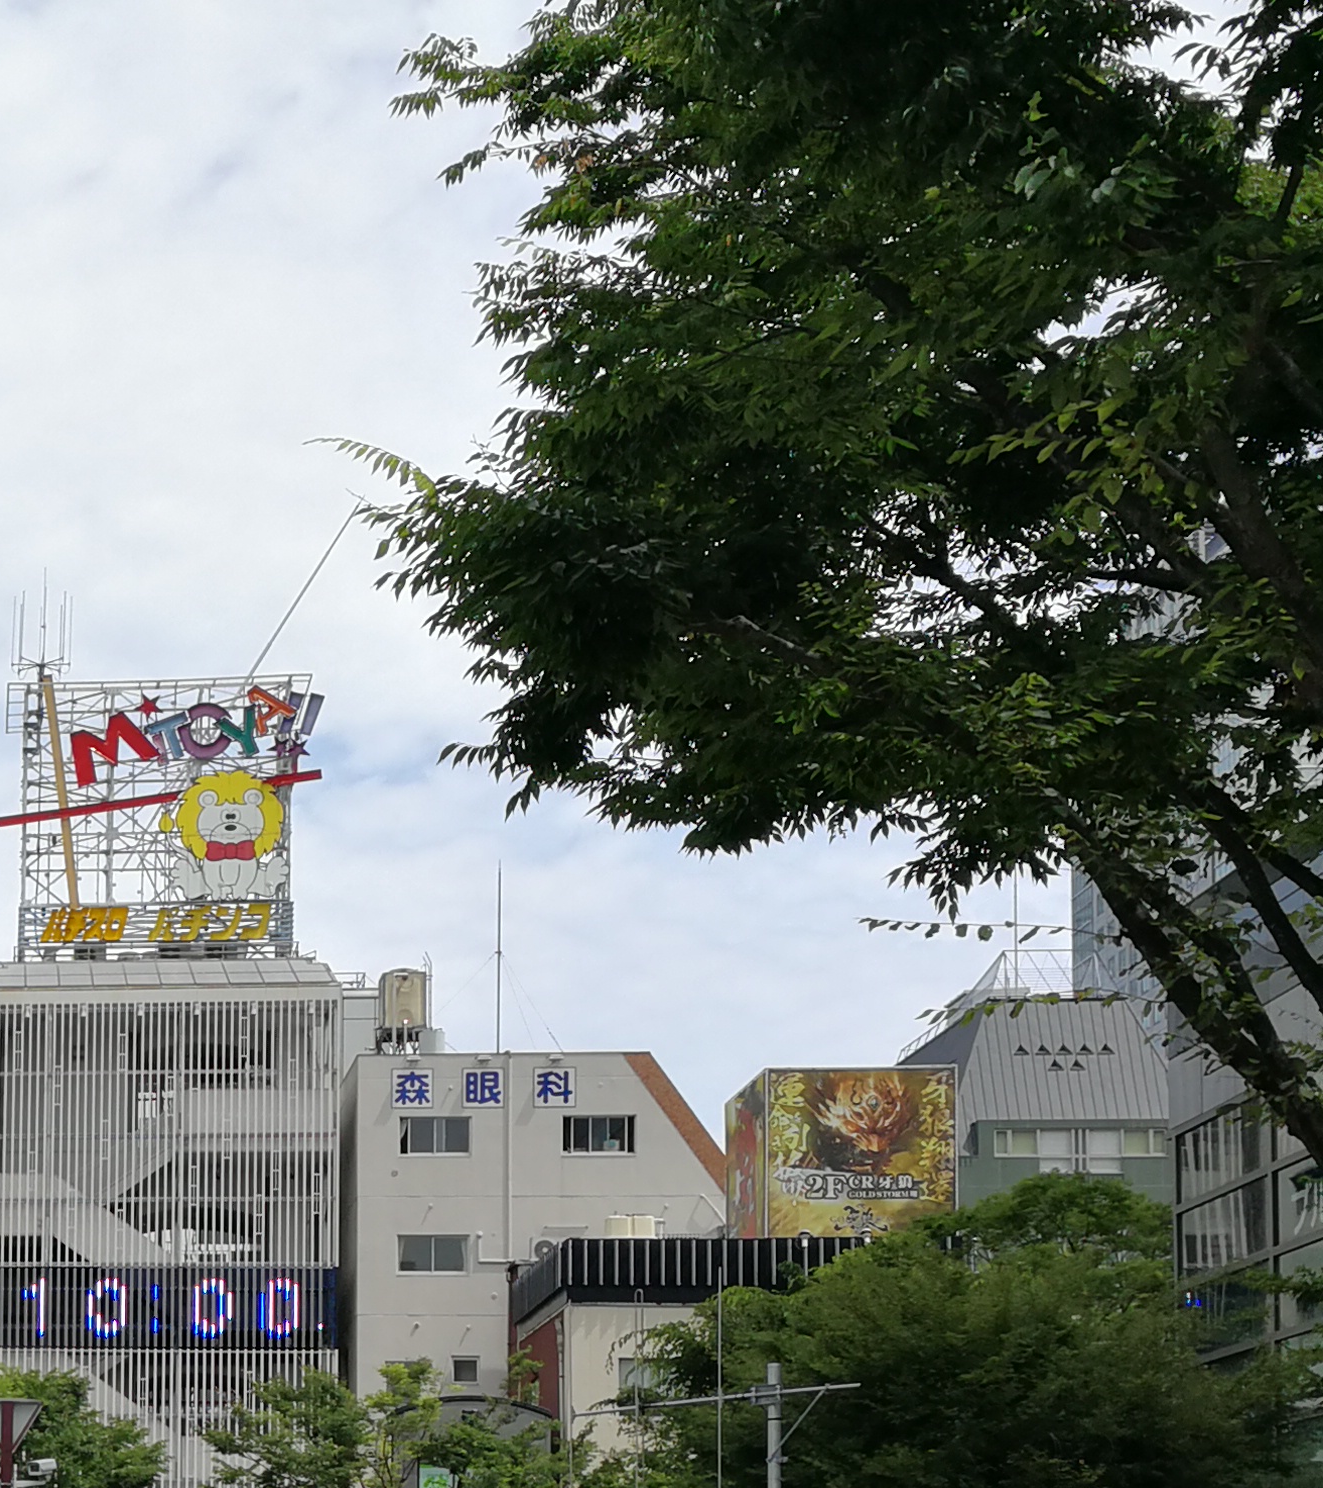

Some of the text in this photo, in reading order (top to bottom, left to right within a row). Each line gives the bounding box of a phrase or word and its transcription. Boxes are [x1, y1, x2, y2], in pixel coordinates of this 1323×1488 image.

[148, 903, 272, 940] パチンコ
[395, 1071, 573, 1105] 森眼科
[807, 1175, 846, 1199] 2F
